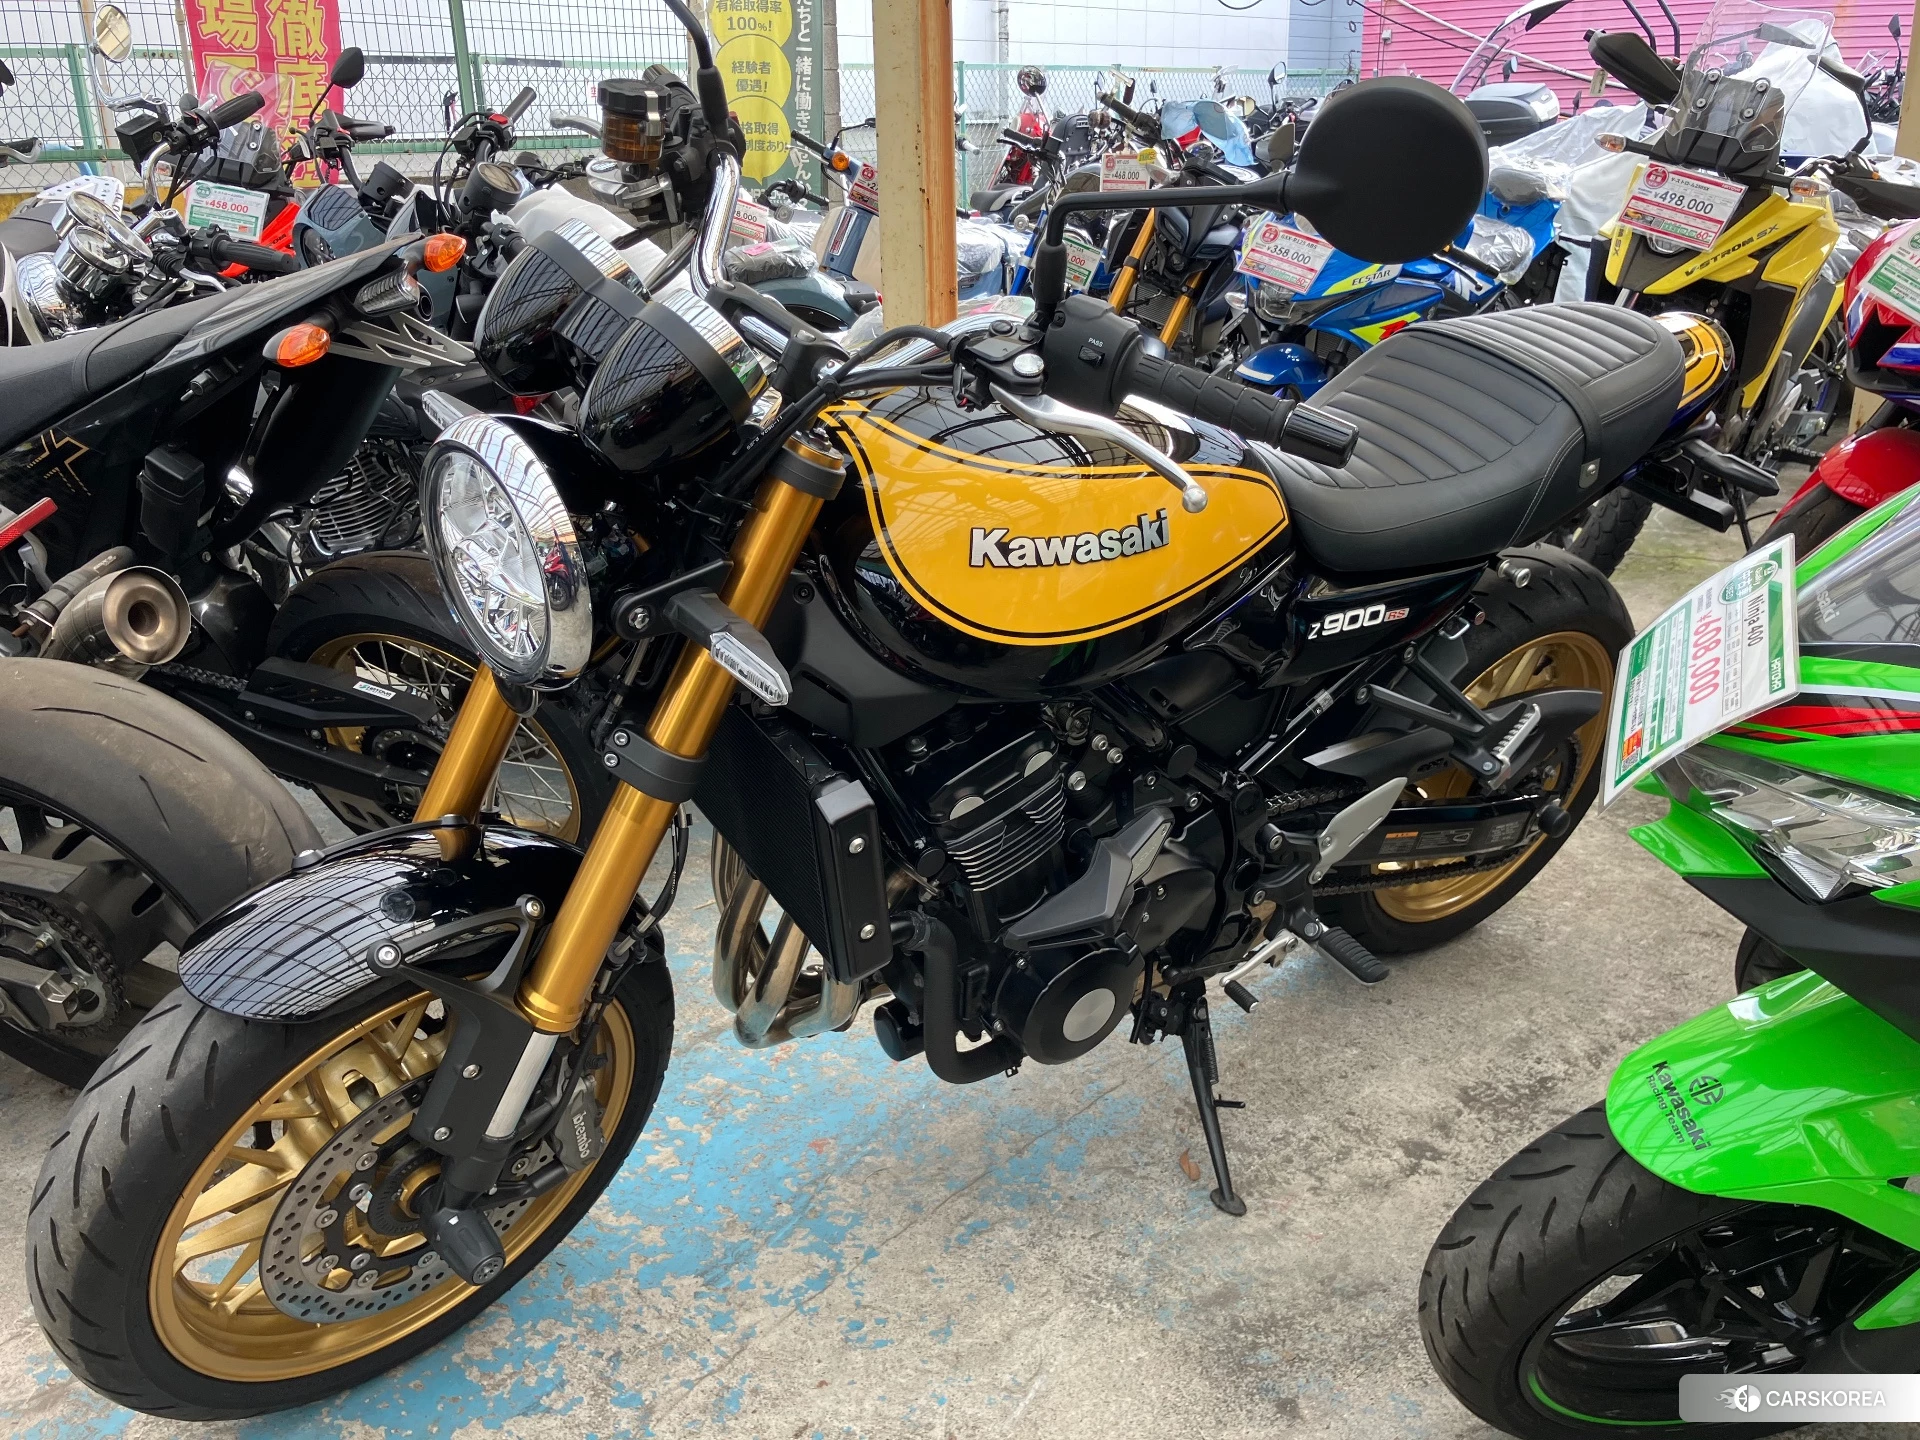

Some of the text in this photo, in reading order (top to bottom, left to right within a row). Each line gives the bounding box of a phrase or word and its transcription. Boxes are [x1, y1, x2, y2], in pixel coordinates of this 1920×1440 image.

[716, 0, 782, 13] 有給取得率
[727, 17, 772, 31] 100%!
[731, 61, 771, 74] 経験者
[736, 79, 767, 92] 優遇!
[205, 199, 249, 214] ¥458,000
[1653, 190, 1714, 215] ¥498,000
[1266, 244, 1312, 265] ¥358,000
[1684, 223, 1779, 277] V-STROM SX
[1351, 269, 1391, 286] ECSTAR
[1088, 337, 1104, 348] PASS
[969, 507, 1170, 569] Kawasaki
[1744, 594, 1765, 647] Ninja 400
[1688, 610, 1722, 705] ¥608,000
[1771, 657, 1782, 691] HATOYA
[1646, 1074, 1685, 1143] Racing Team
[1652, 1060, 1712, 1151] Kawasaki
[572, 1110, 592, 1158] brembo
